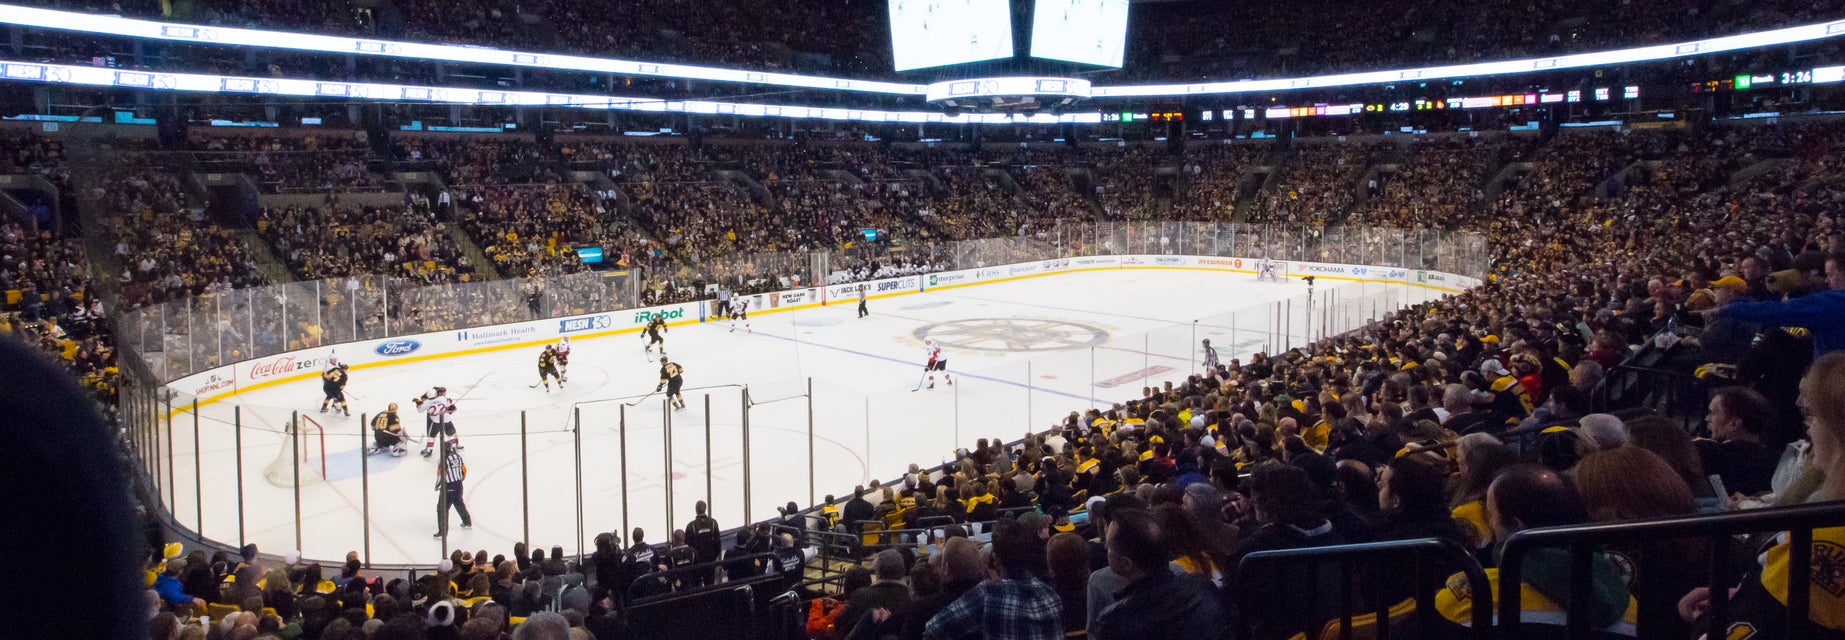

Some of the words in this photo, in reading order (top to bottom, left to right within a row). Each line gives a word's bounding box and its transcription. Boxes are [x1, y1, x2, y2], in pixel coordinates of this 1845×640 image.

[1782, 71, 1811, 84] 3:26
[1390, 102, 1409, 111] 4:29
[1198, 259, 1233, 267] SYLVANIA
[1308, 265, 1345, 273] YOKOHAMA
[840, 286, 854, 294] JACK
[877, 278, 915, 292] SUPERCUTS
[564, 318, 590, 332] NESN
[596, 315, 611, 330] 30
[472, 329, 508, 340] Hallmark
[511, 326, 536, 335] Health
[383, 341, 413, 354] Ford
[296, 357, 328, 370] zero
